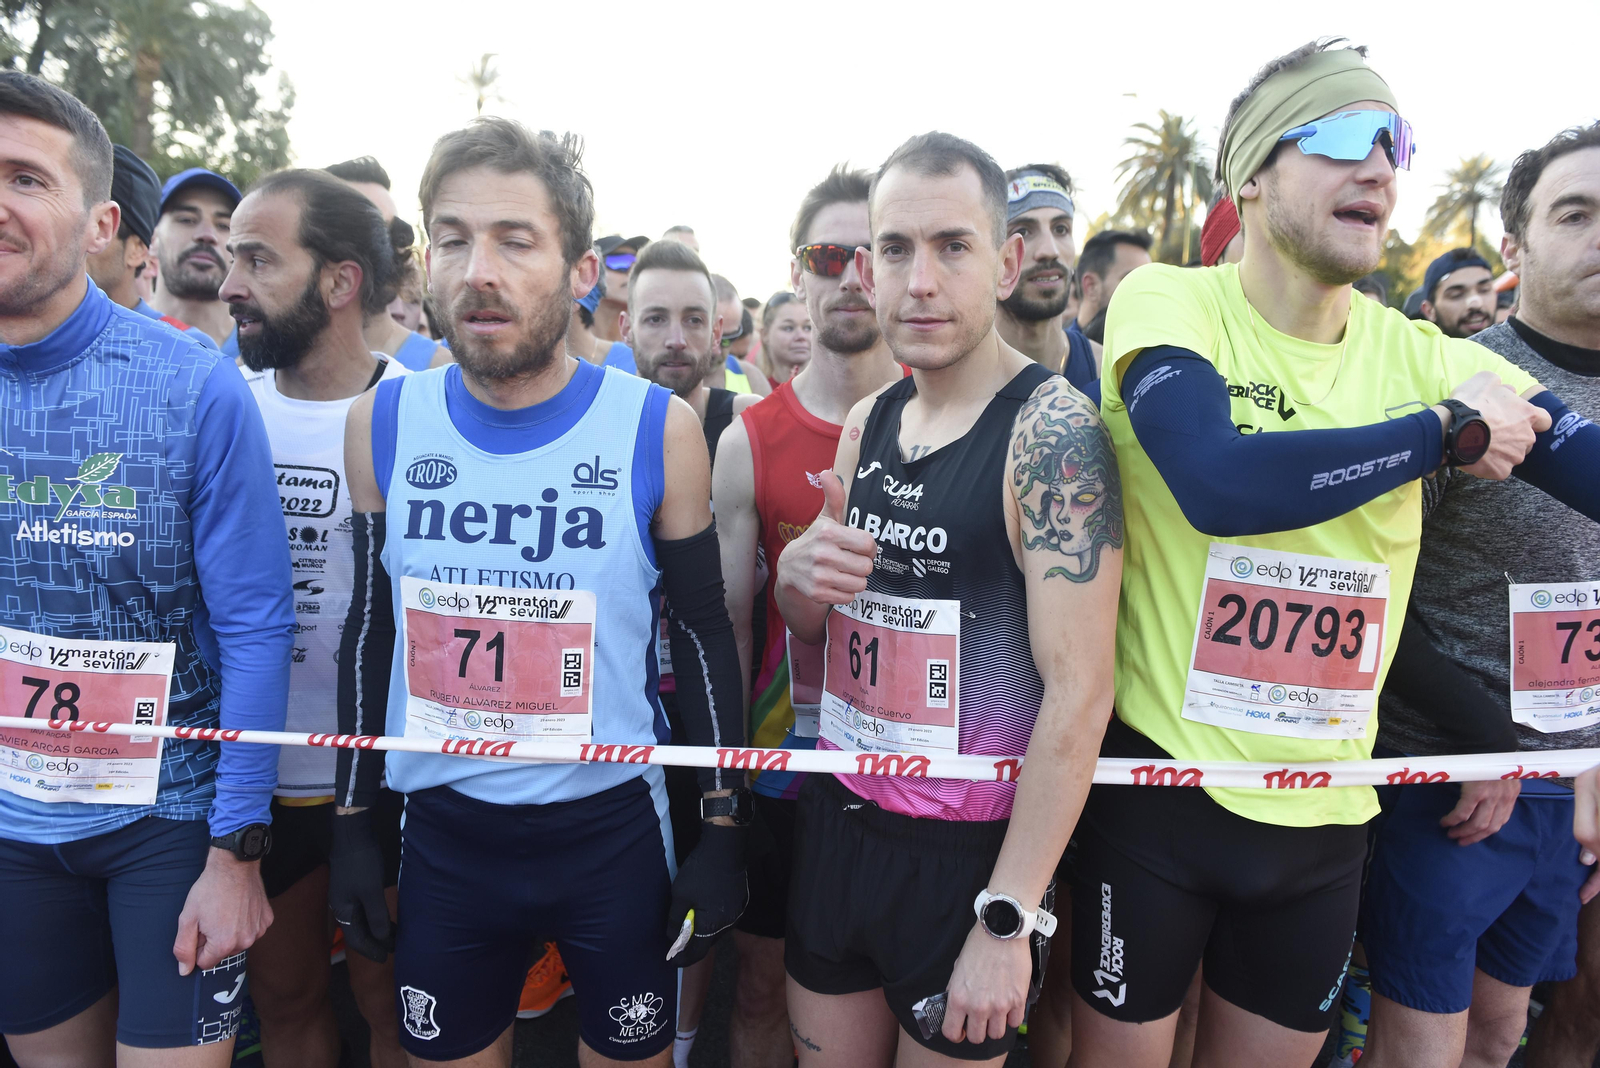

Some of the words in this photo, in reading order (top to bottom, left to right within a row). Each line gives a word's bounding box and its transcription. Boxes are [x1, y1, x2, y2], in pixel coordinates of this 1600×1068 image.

[407, 460, 456, 484] TROPS
[1310, 450, 1412, 491] BOOSTER
[275, 471, 333, 490] tama
[102, 510, 137, 520] ESPADA
[16, 520, 135, 547] Atletismo
[404, 487, 607, 563] nerja
[865, 513, 948, 554] BARCO
[926, 559, 951, 568] DEPORTE
[927, 565, 949, 575] GALEGO
[1256, 561, 1292, 583] edp
[1316, 567, 1369, 583] maratón
[1329, 579, 1369, 593] sevilla
[438, 592, 470, 612] edp
[494, 595, 558, 609] maratón
[1555, 588, 1588, 606] edp
[510, 606, 559, 619] sevilla
[871, 601, 922, 619] maratón
[883, 614, 922, 629] sevilla
[1204, 616, 1215, 640] CAJÓN
[1211, 593, 1366, 660] 20793
[10, 640, 42, 660] edp
[68, 647, 136, 661] maratón
[454, 628, 505, 683] 71
[849, 630, 879, 687] 61
[83, 657, 135, 670] sevilla
[1528, 679, 1575, 689] alejandro
[1578, 674, 1600, 685] ferna
[22, 675, 81, 721] 78
[430, 690, 461, 705] RUBEN
[462, 696, 512, 710] ALVAREZ
[515, 701, 558, 711] MIGUEL
[1288, 687, 1319, 707] edp
[483, 713, 514, 732] edp
[877, 707, 912, 720] Cuervo
[1245, 709, 1271, 720] HOKA
[1563, 710, 1583, 719] HOKA
[843, 729, 855, 744] HOKA
[861, 719, 885, 737] edp
[31, 741, 70, 754] ARCAS
[74, 745, 119, 756] GARCIA
[46, 758, 79, 776] edp
[9, 773, 31, 785] HOKA
[1100, 882, 1112, 970] EXPERIENCE
[1110, 936, 1125, 977] ROCK
[620, 992, 654, 1008] CMD
[619, 1020, 657, 1037] NERJA
